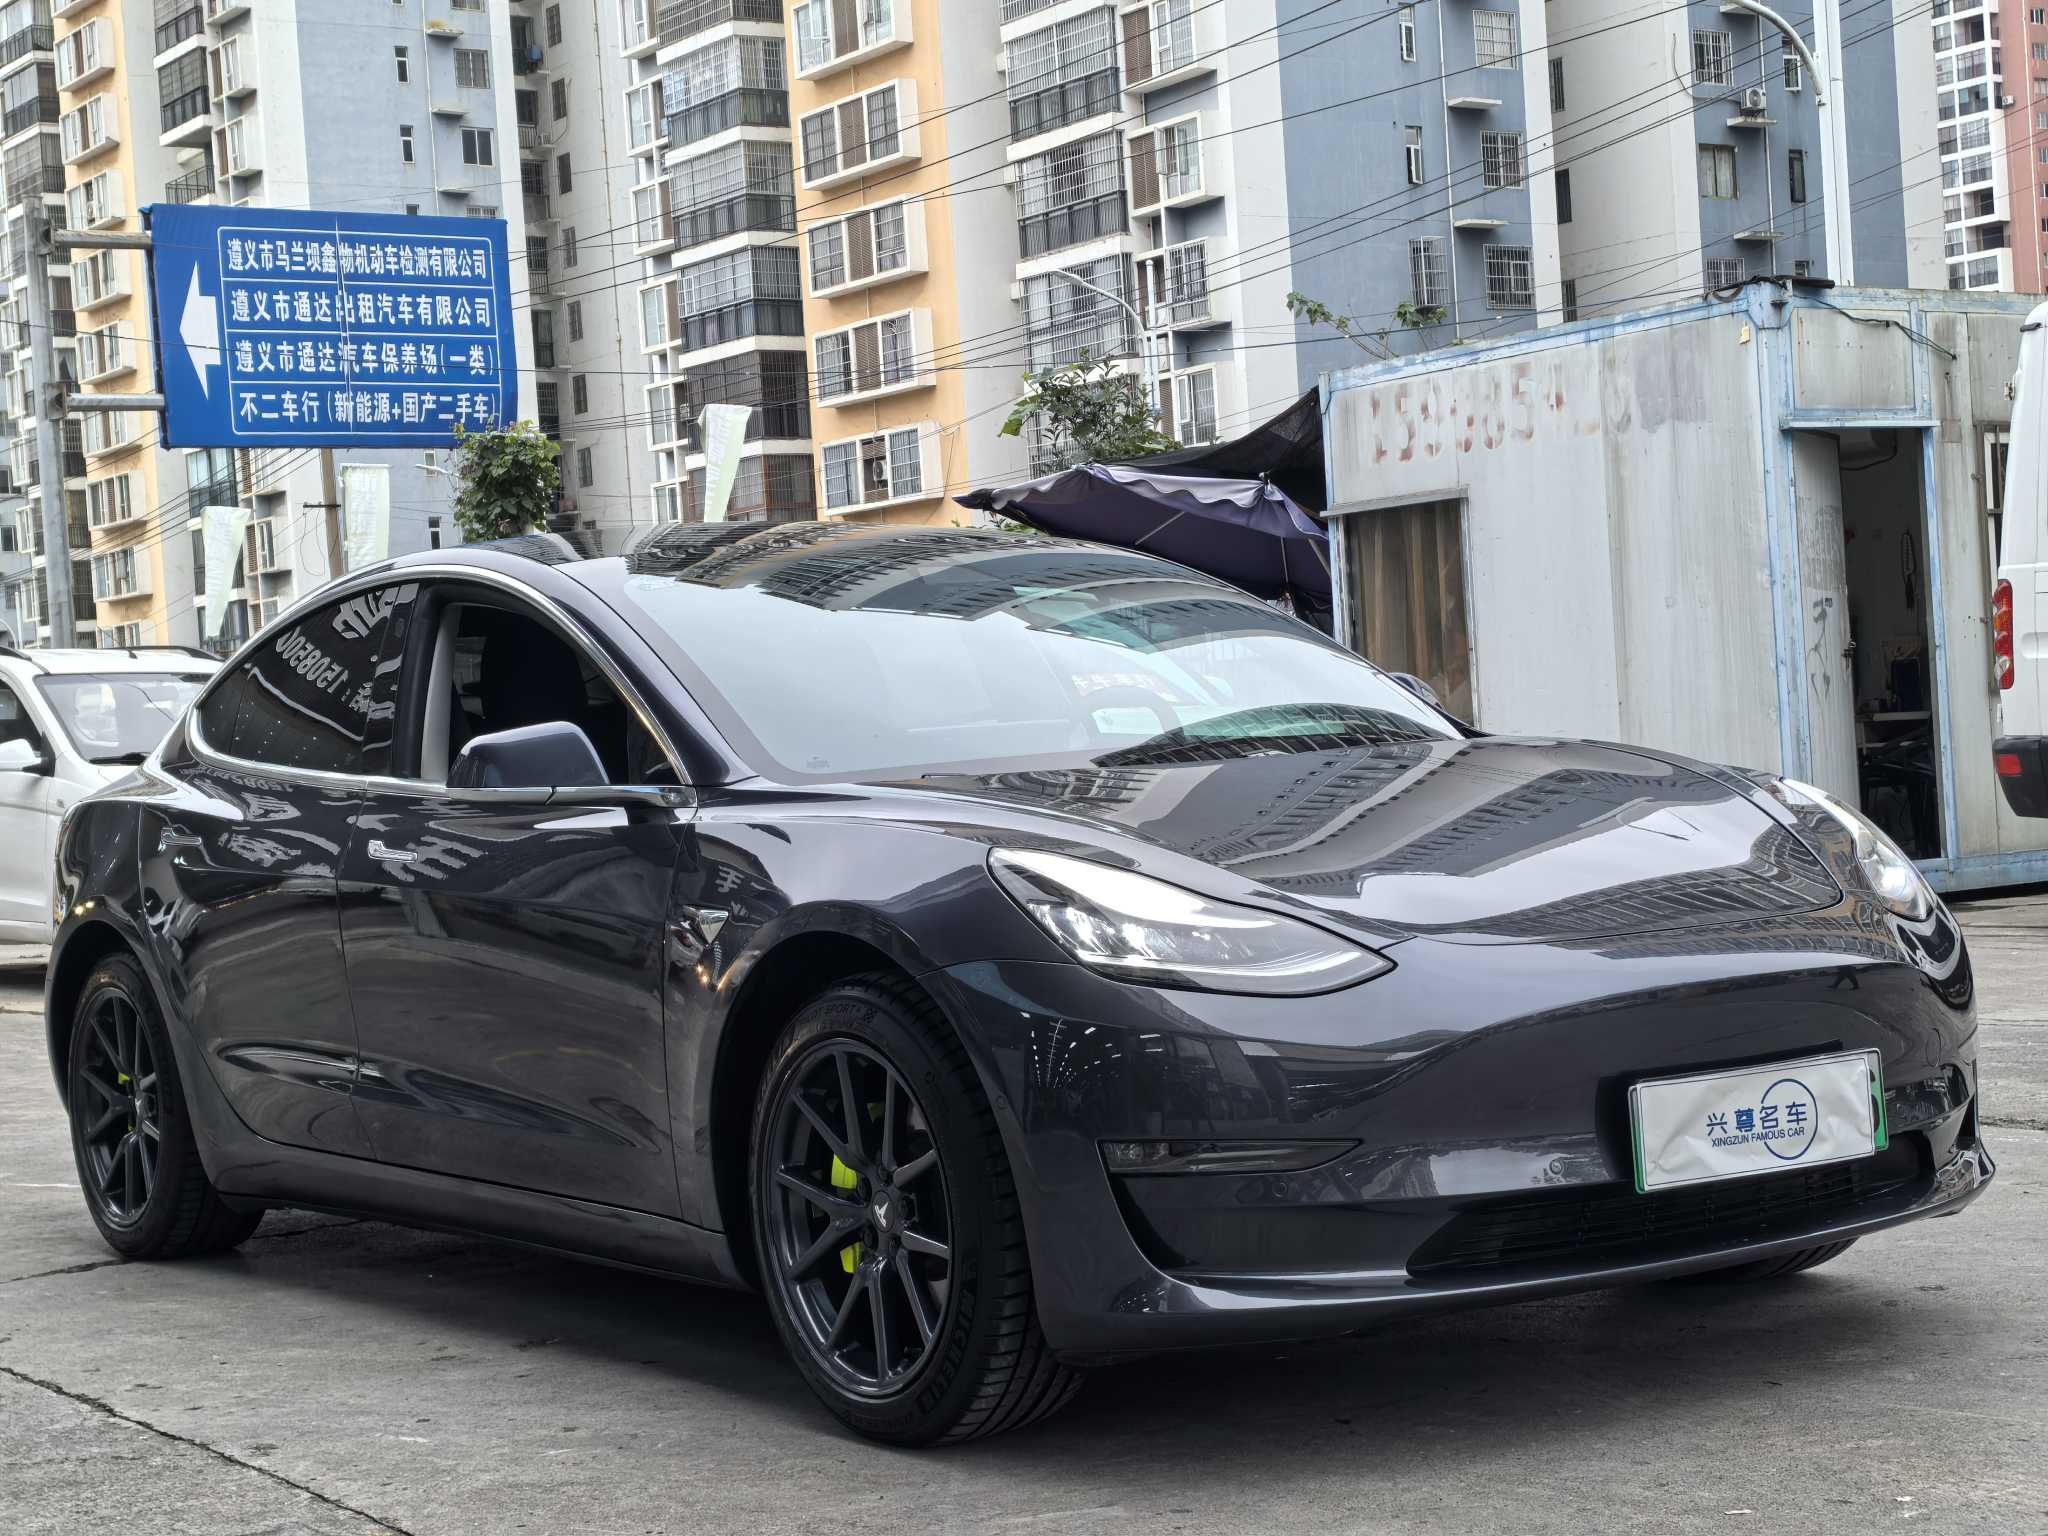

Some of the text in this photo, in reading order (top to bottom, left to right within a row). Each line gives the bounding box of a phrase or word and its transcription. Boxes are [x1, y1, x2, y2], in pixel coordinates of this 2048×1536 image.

[231, 289, 492, 328] 遵义市通达出租汽车有限公司
[1706, 1101, 1808, 1136] 兴尊名车
[1711, 1126, 1805, 1148] XINGZUN FAMOUS CAR
